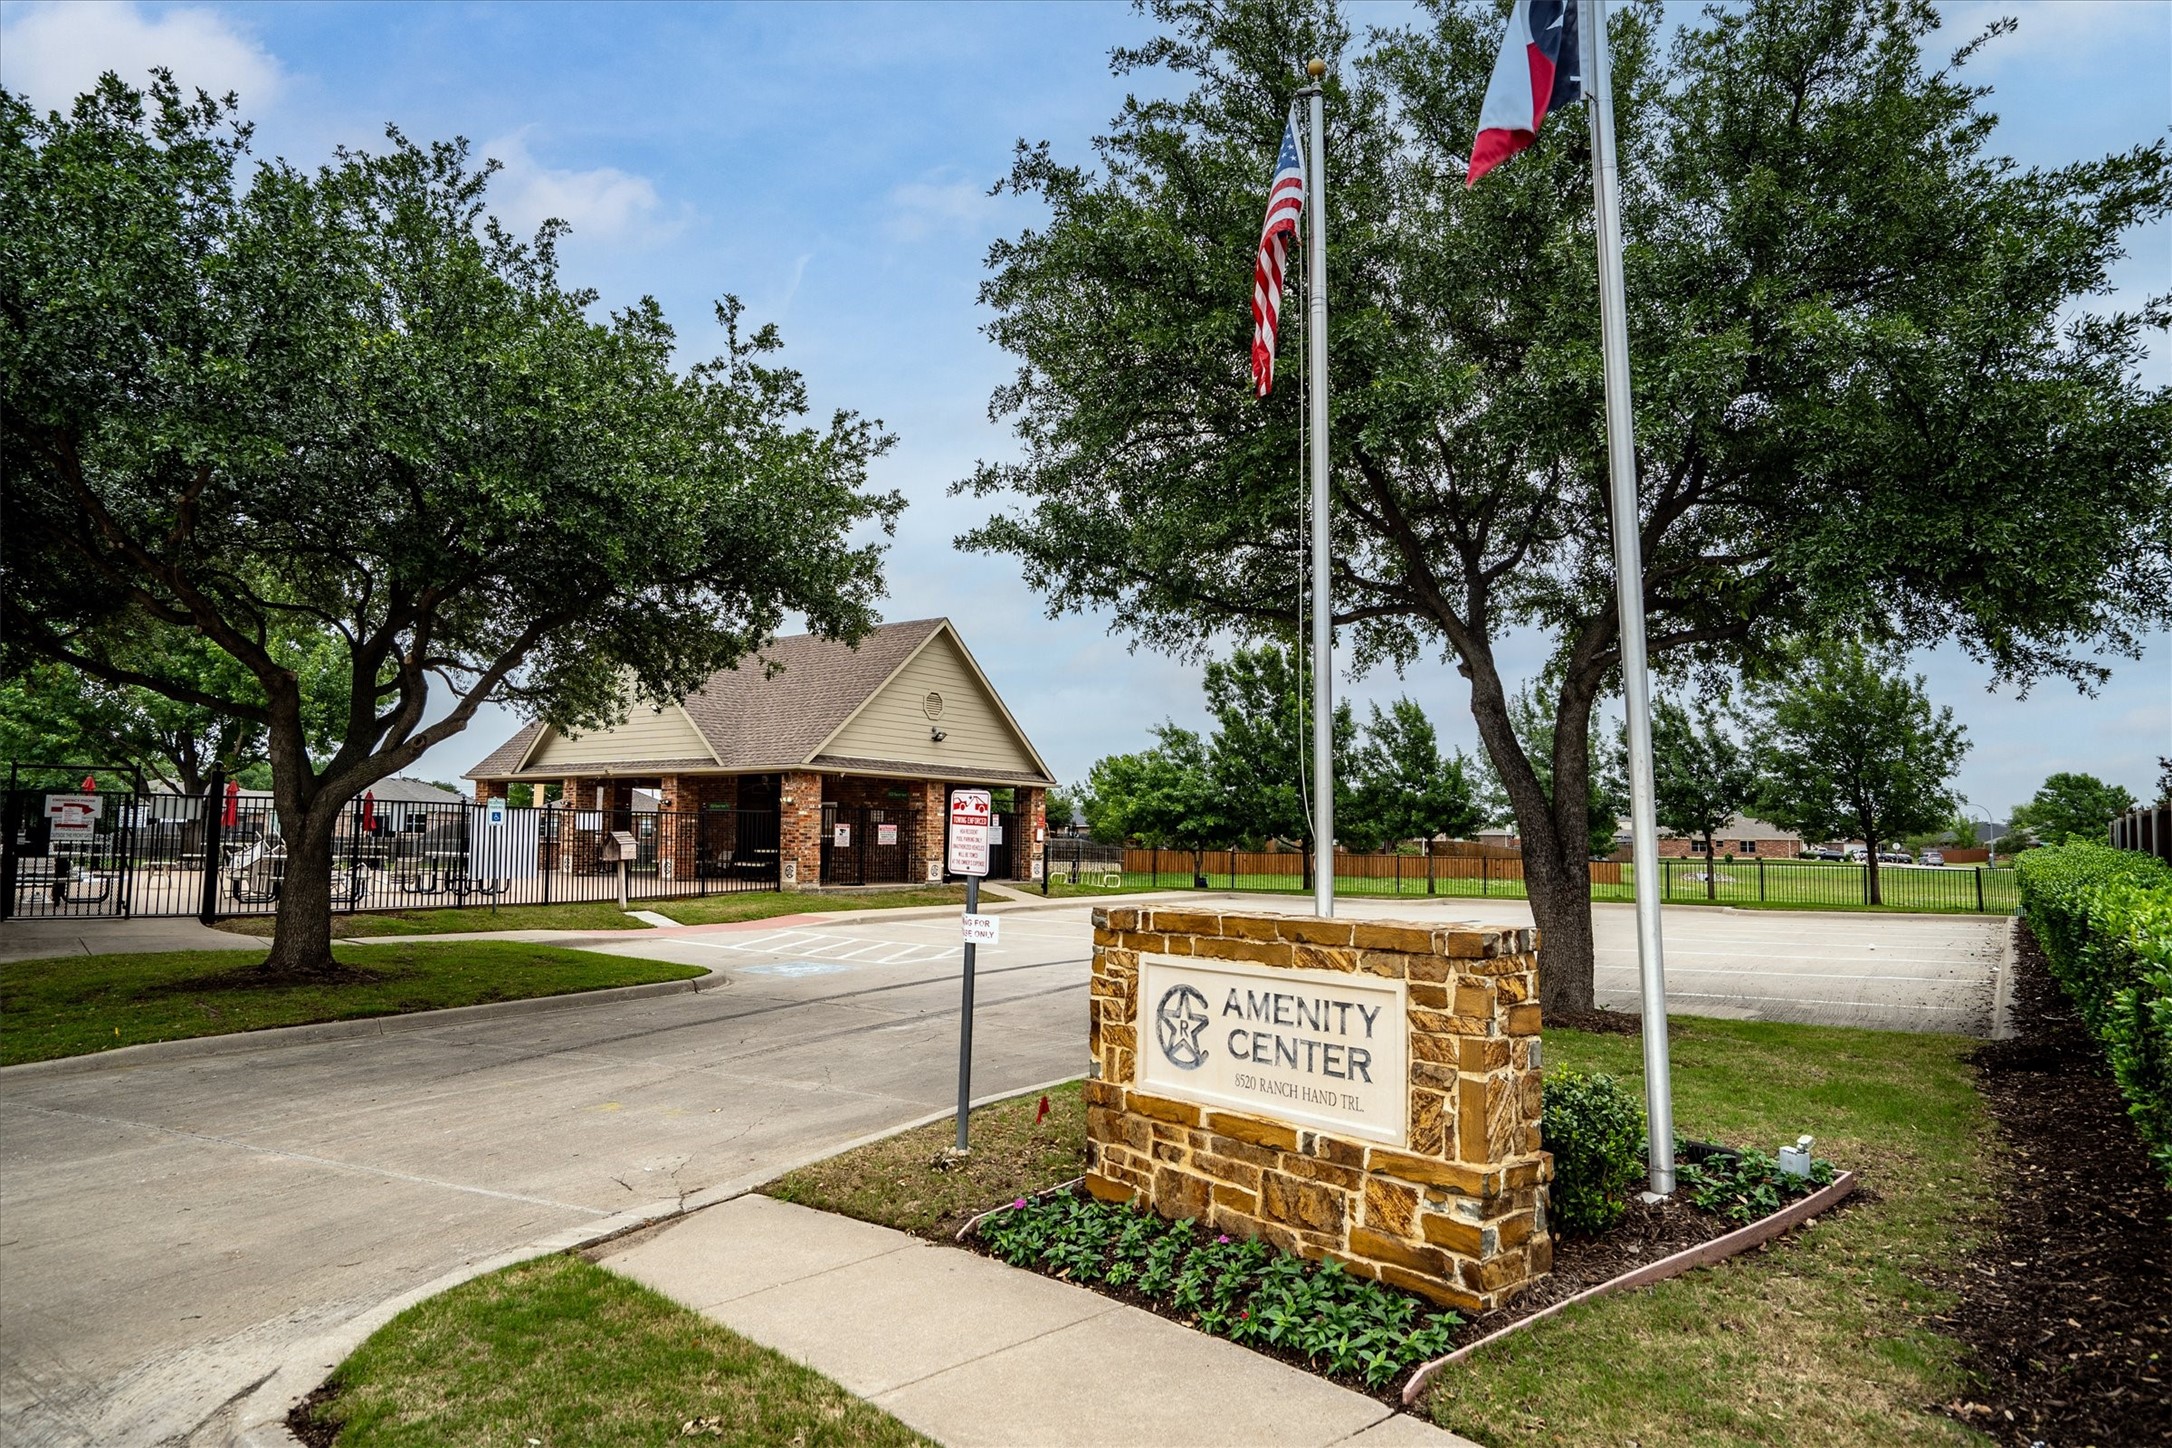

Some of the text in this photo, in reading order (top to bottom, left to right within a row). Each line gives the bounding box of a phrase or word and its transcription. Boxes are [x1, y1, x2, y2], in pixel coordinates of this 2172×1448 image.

[968, 816, 986, 825] ENFORCED
[974, 919, 990, 928] FOR
[974, 930, 994, 938] ONLY
[1222, 988, 1382, 1039] AMENITY
[1227, 1028, 1374, 1085] CENTER
[1234, 1074, 1365, 1112] 8520 RANCH HAND TRL.
